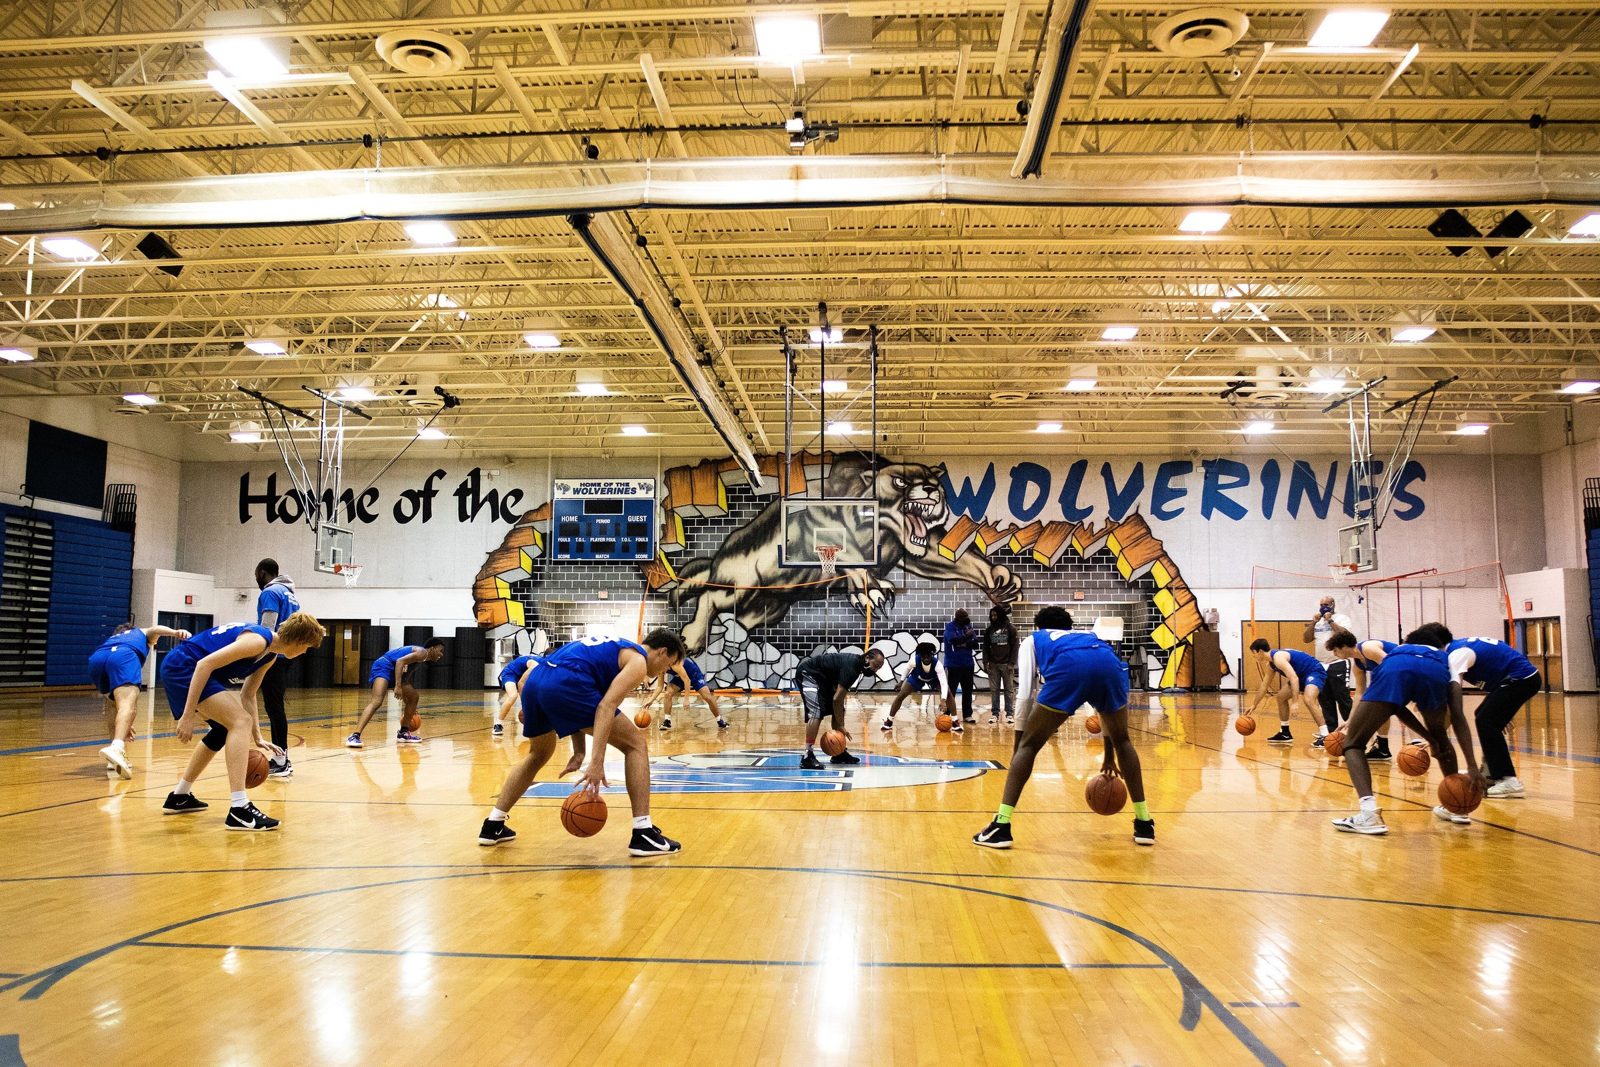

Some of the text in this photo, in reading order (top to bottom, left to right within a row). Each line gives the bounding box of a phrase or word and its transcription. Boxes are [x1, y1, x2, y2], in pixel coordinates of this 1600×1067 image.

[239, 467, 524, 524] Home of the
[572, 487, 637, 495] WOLVERINES
[938, 458, 1426, 521] WOLVERINES
